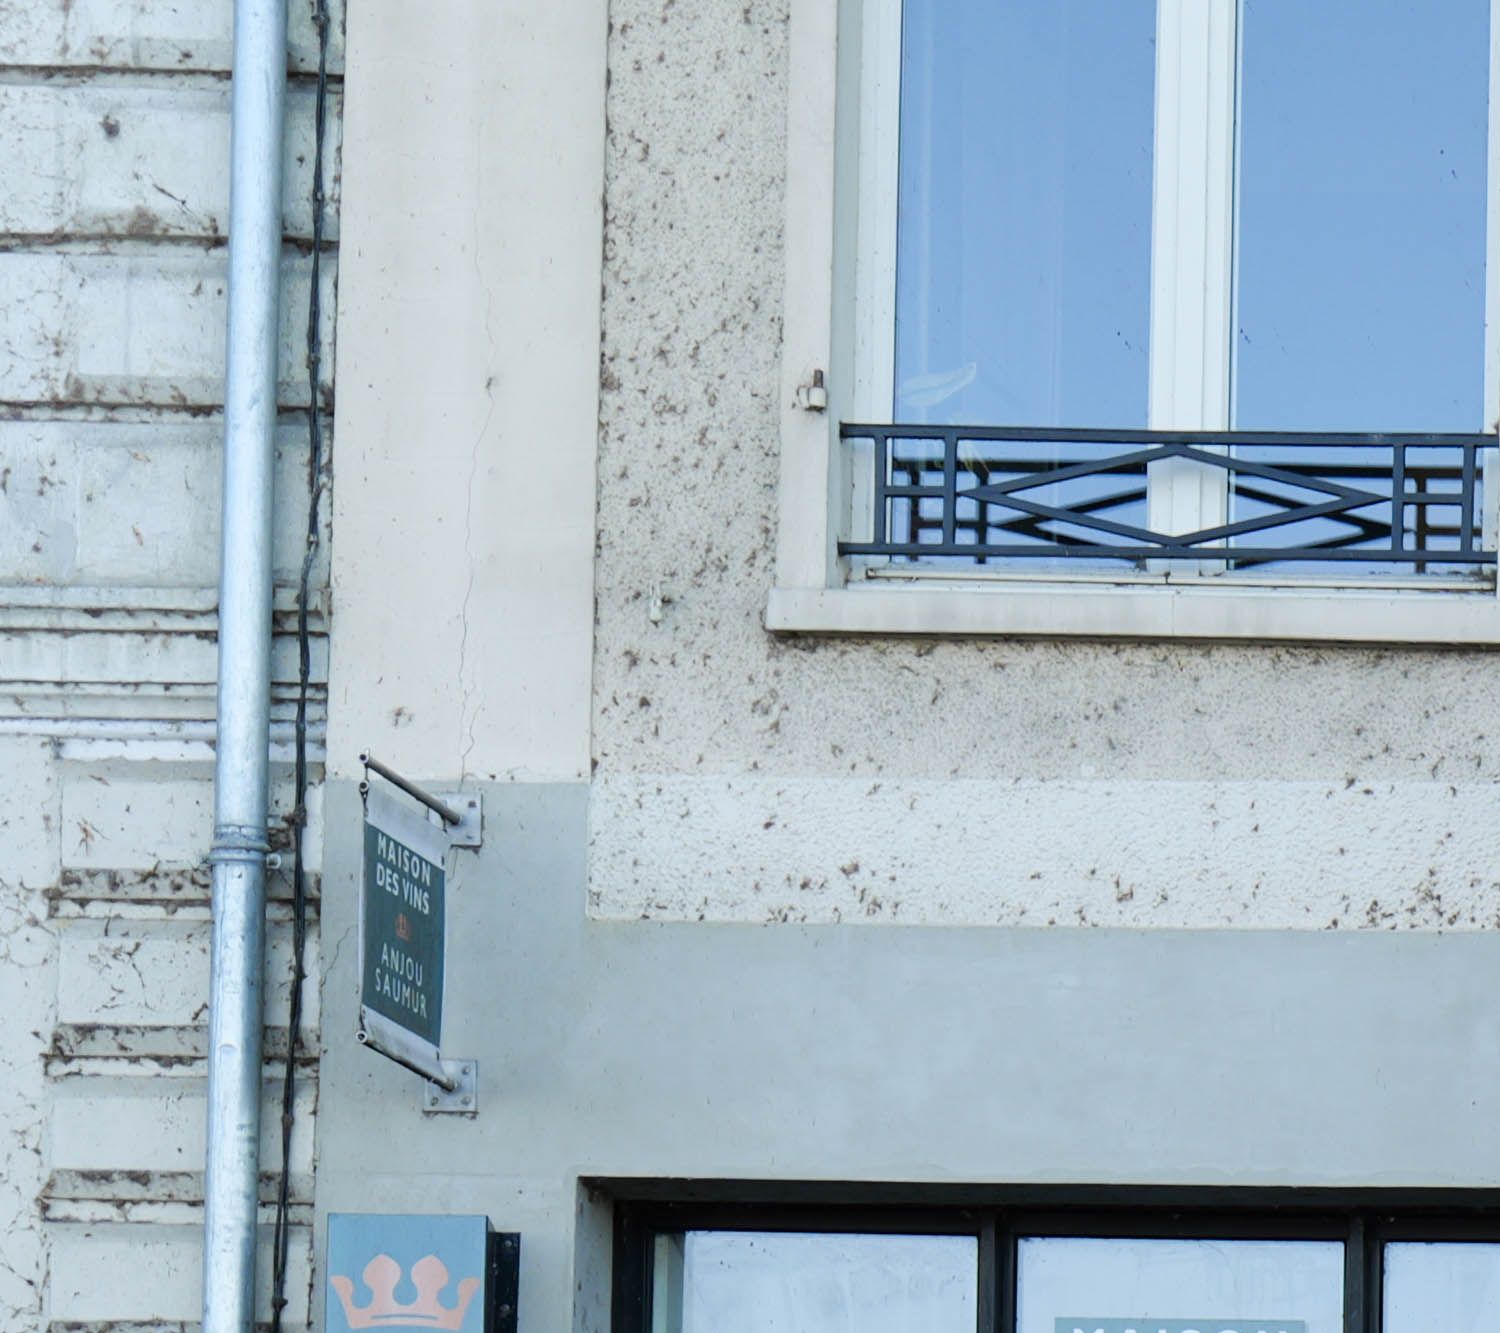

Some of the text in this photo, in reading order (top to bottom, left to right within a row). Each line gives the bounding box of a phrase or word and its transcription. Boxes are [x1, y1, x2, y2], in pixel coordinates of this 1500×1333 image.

[377, 832, 431, 887] MAISON
[376, 862, 430, 915] DES VINS
[381, 942, 423, 987] ANJOU
[375, 967, 427, 1018] SAUMUR
